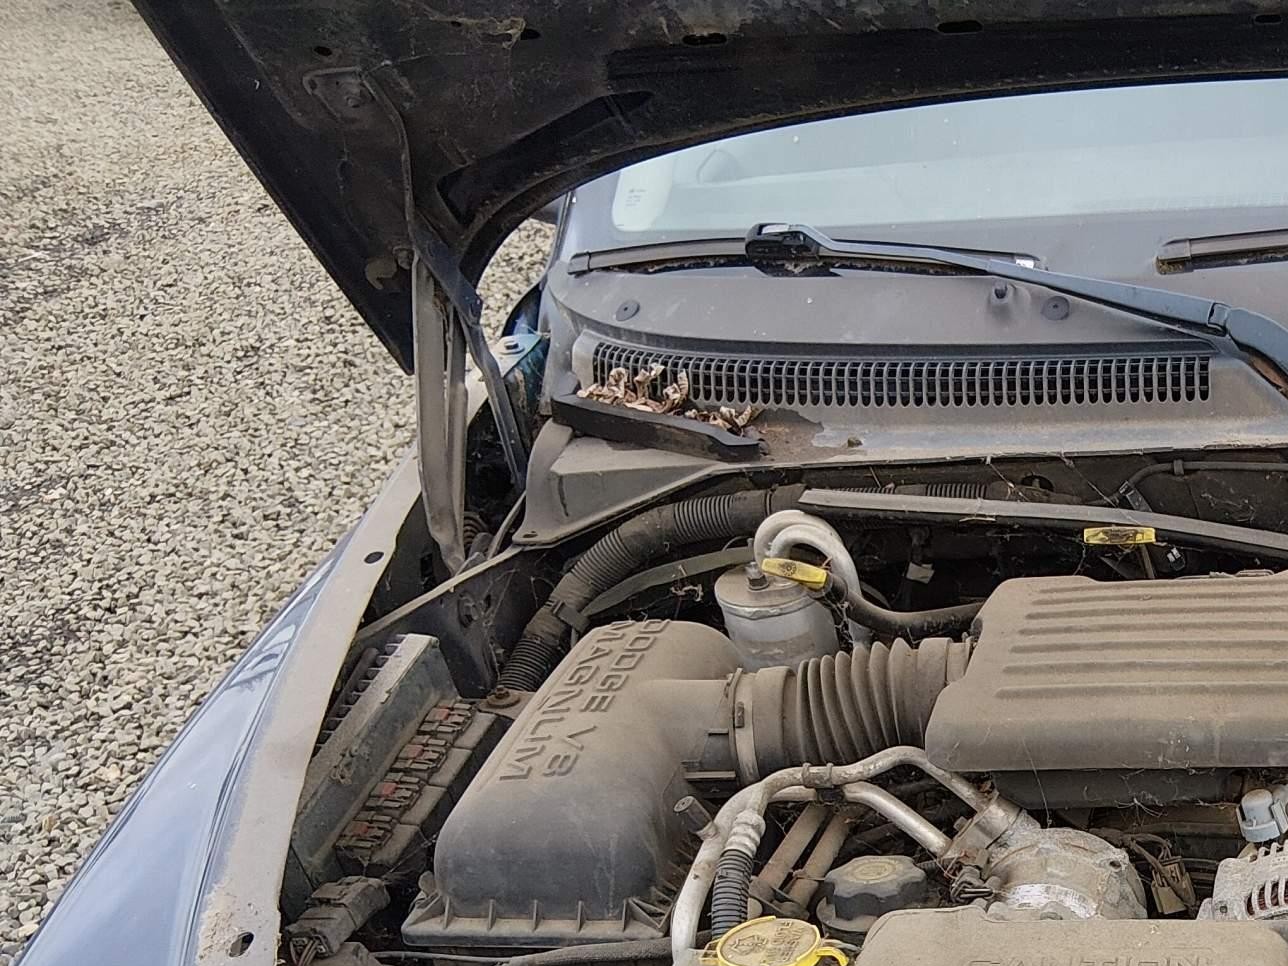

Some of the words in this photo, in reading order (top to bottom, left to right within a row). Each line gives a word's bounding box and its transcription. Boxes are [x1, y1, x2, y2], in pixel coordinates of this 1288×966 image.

[499, 621, 636, 781] MAGNUM
[580, 619, 671, 713] DODGE
[542, 725, 597, 778] V8
